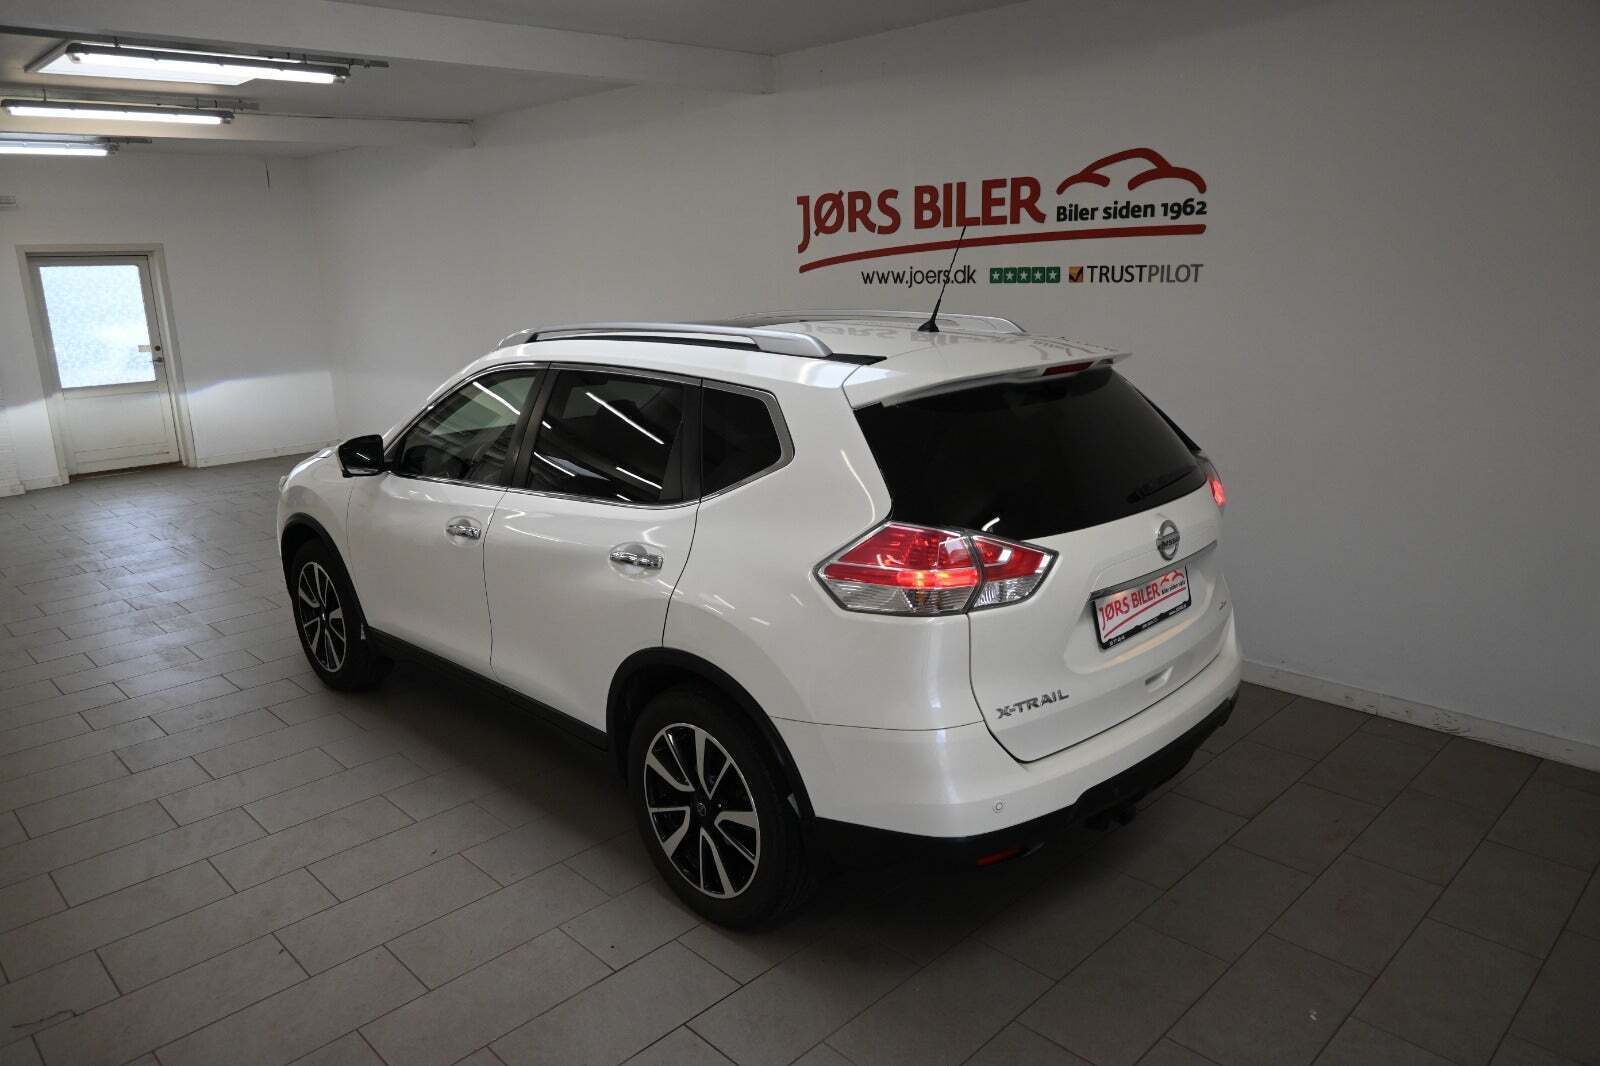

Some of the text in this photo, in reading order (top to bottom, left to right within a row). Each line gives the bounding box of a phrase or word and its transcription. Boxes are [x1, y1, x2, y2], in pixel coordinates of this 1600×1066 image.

[797, 177, 1046, 253] JØRS BILER
[1056, 199, 1208, 222] Biler siden 1962
[861, 264, 1204, 288] www.joers.dk TRUSTPILOT
[1099, 595, 1130, 631] JØRS
[1131, 582, 1161, 609] BILER
[996, 689, 1070, 719] X-TRAIL
